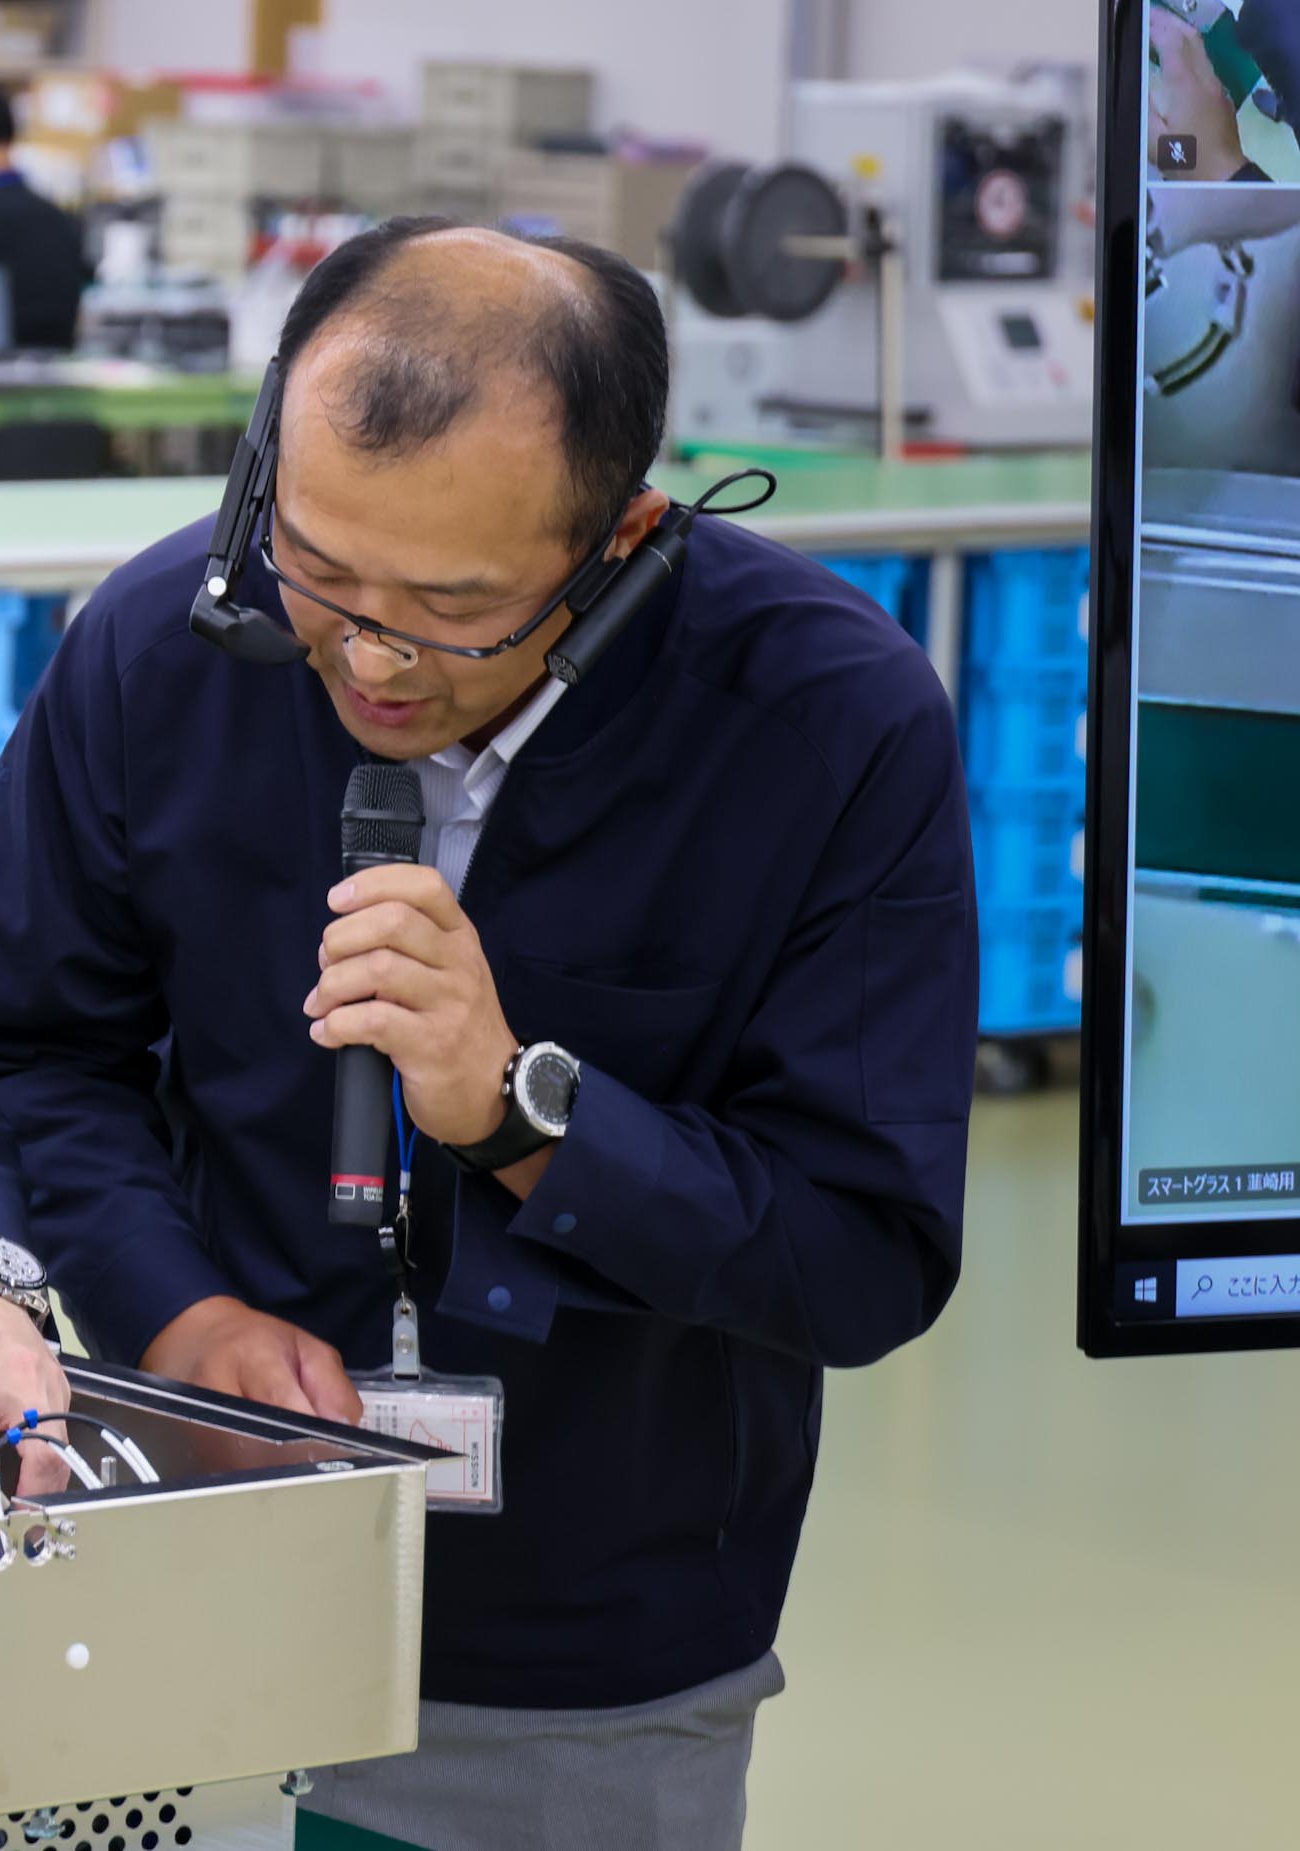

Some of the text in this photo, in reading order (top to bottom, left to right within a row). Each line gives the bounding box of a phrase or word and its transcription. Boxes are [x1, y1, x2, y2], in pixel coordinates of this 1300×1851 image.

[1147, 1173, 1230, 1197] スマートグラス
[471, 1442, 479, 1488] MISSION
